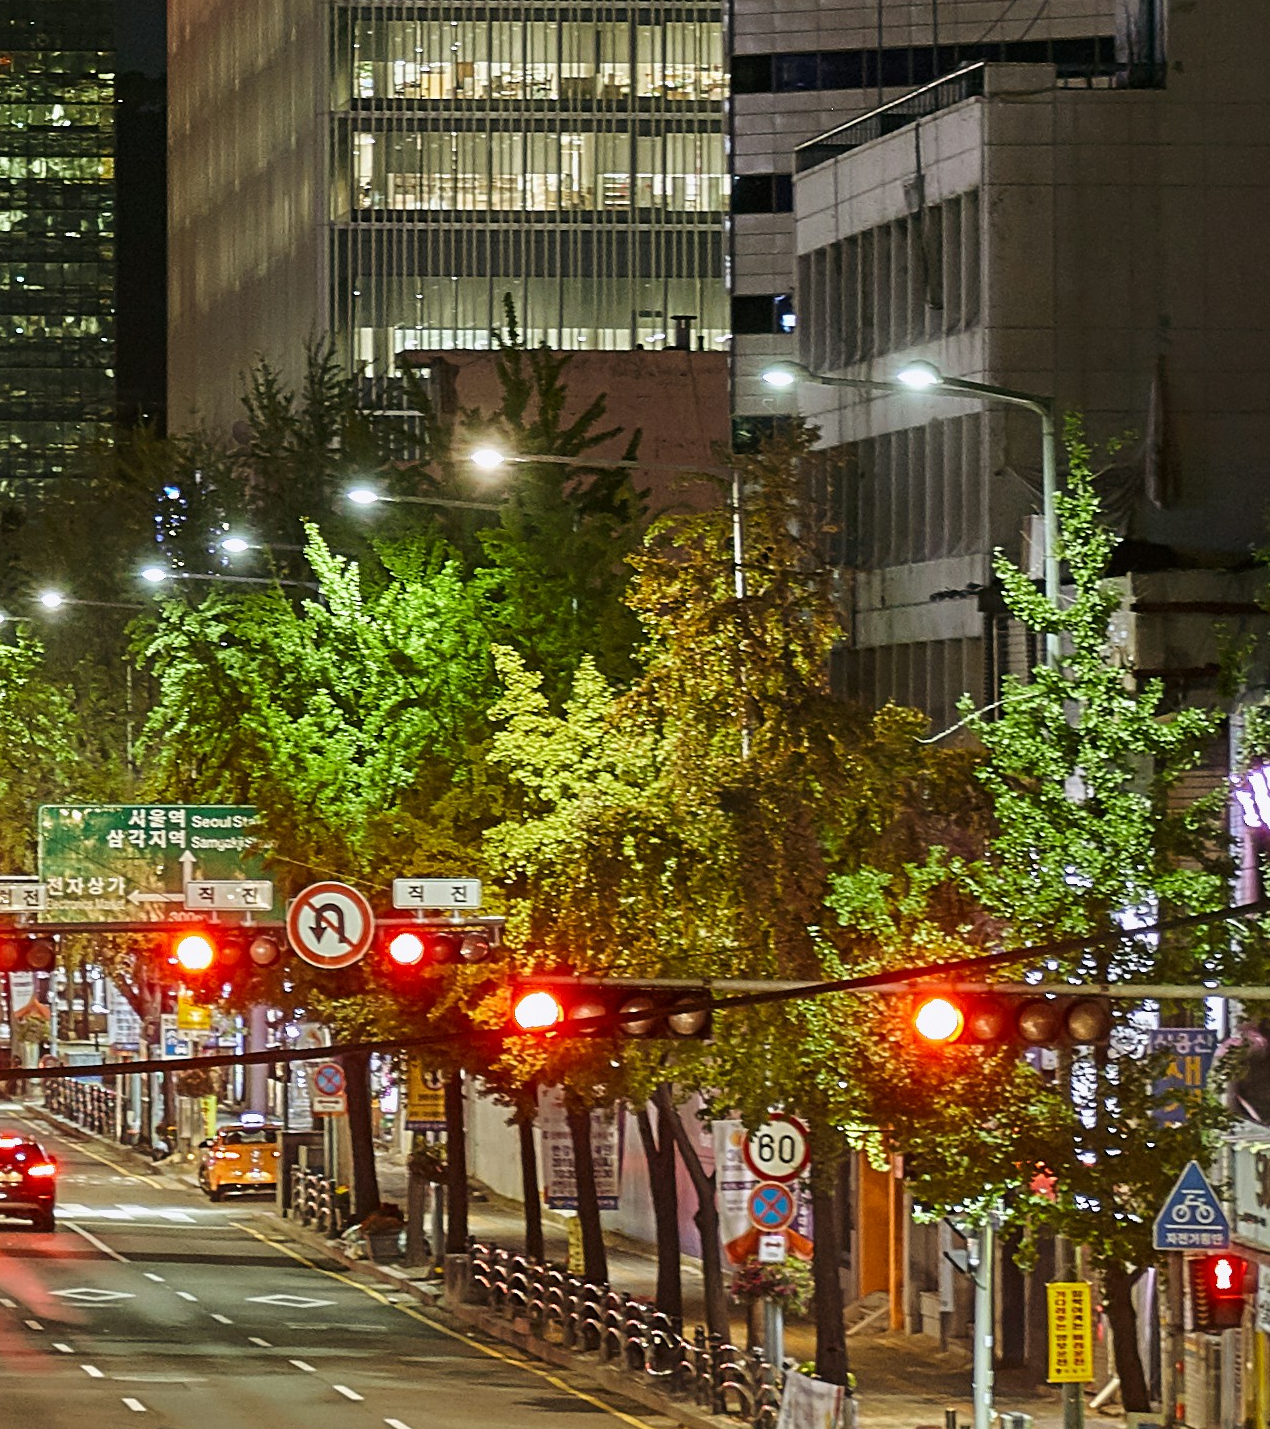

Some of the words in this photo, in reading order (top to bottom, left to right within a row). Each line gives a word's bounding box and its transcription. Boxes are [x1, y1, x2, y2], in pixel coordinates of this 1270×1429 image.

[128, 808, 187, 829] 서울역
[190, 815, 232, 829] Seoul
[106, 829, 187, 850] 삼각지역
[47, 877, 126, 897] 전자상가
[757, 1133, 796, 1164] 60
